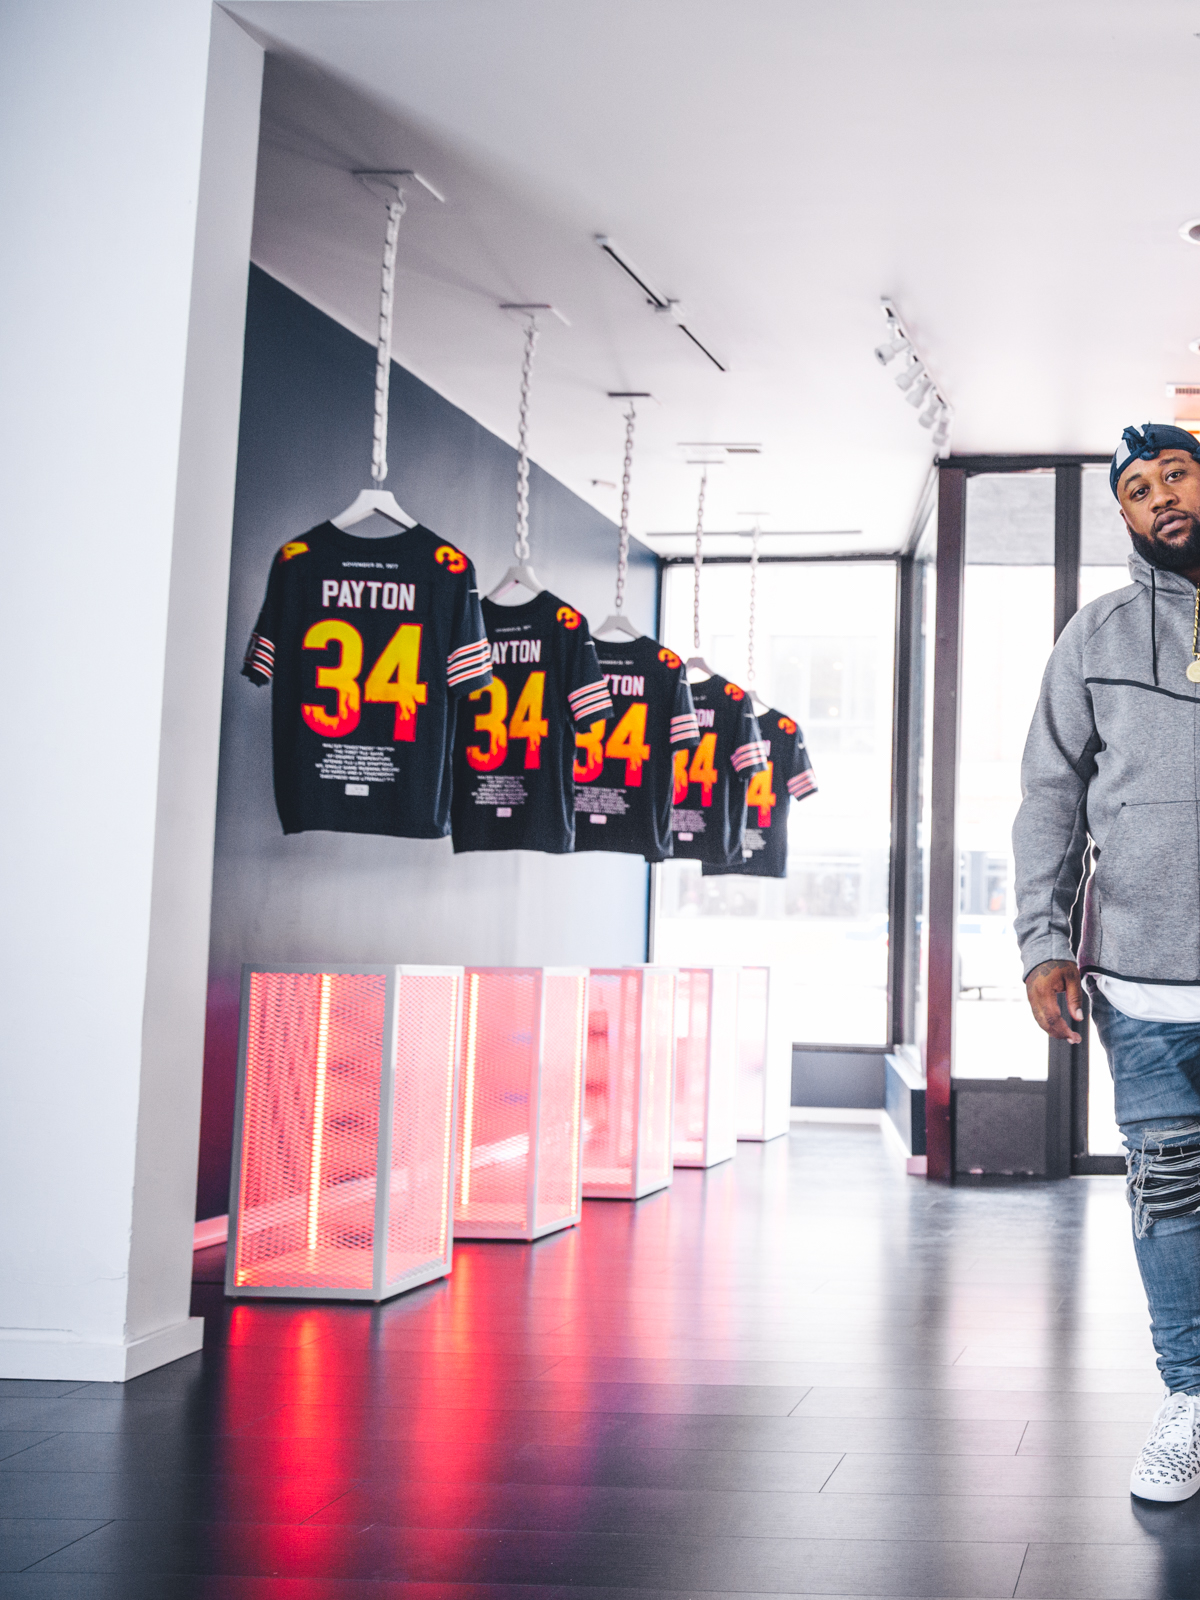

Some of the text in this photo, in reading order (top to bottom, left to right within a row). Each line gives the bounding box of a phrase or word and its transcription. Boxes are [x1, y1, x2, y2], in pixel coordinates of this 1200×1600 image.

[322, 580, 416, 611] PAYTON
[300, 619, 428, 743] 34
[489, 639, 541, 664] AYTON
[466, 671, 549, 772] 34
[573, 702, 651, 787] 34
